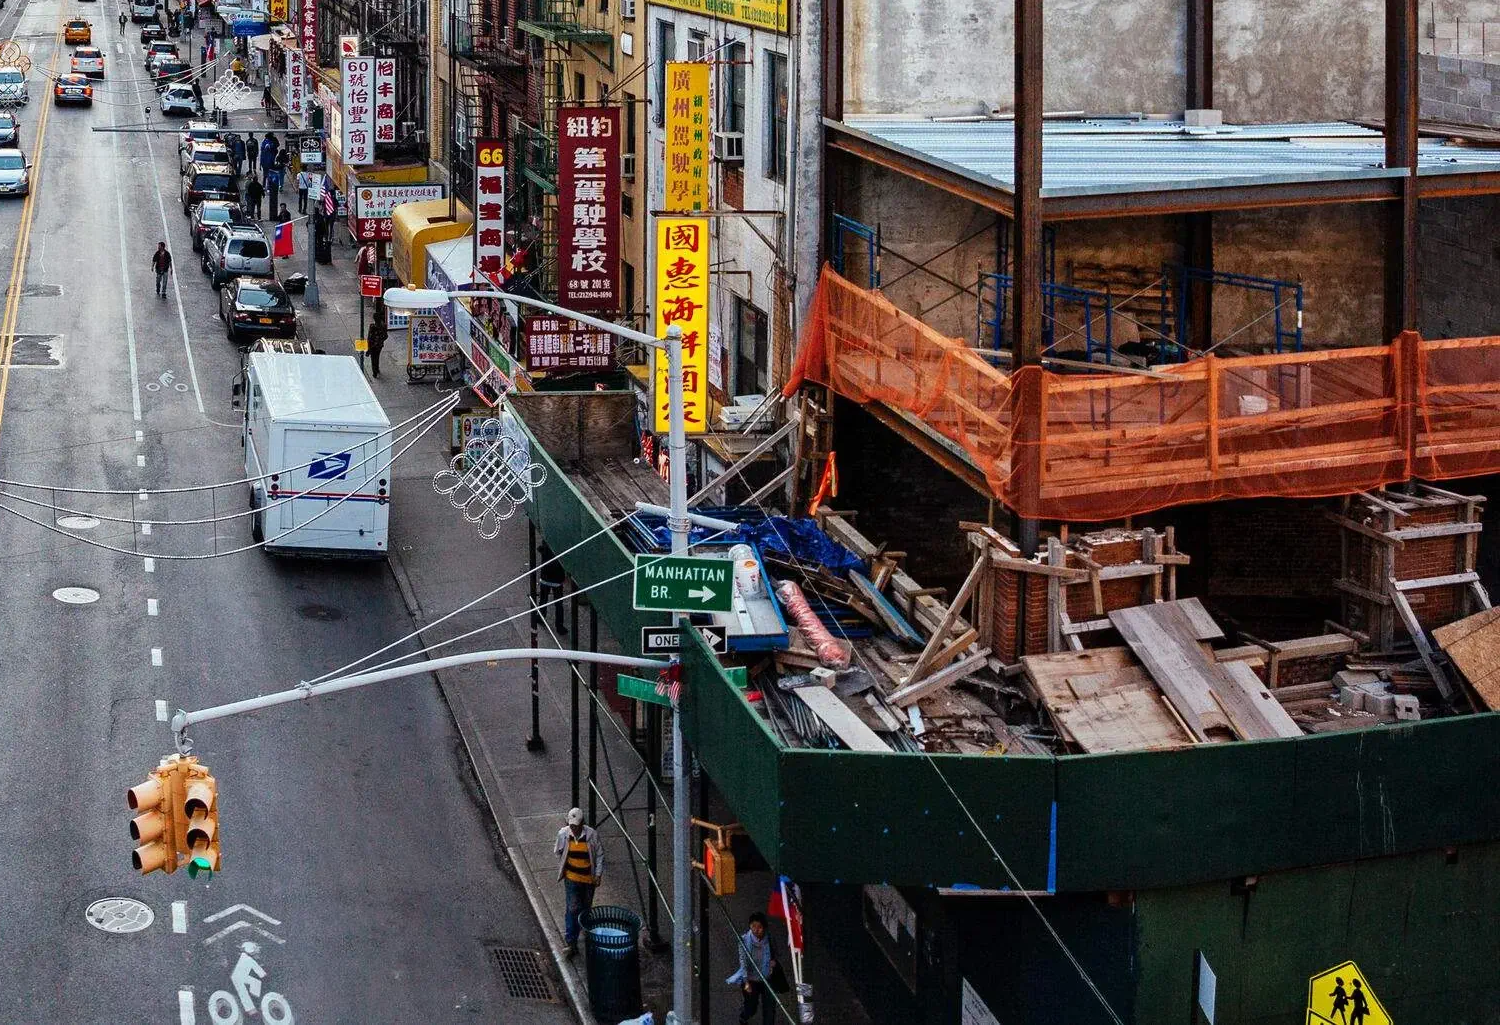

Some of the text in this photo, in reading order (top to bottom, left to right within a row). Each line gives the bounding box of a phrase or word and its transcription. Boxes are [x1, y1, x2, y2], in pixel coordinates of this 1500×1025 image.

[566, 117, 612, 138] 紐約
[671, 70, 691, 213] 廣州駕駛學
[479, 148, 504, 165] 66
[571, 147, 607, 273] 第一駕駛學校
[645, 565, 725, 582] MANHATTAN
[651, 585, 672, 599] BR.
[655, 635, 679, 646] ONE
